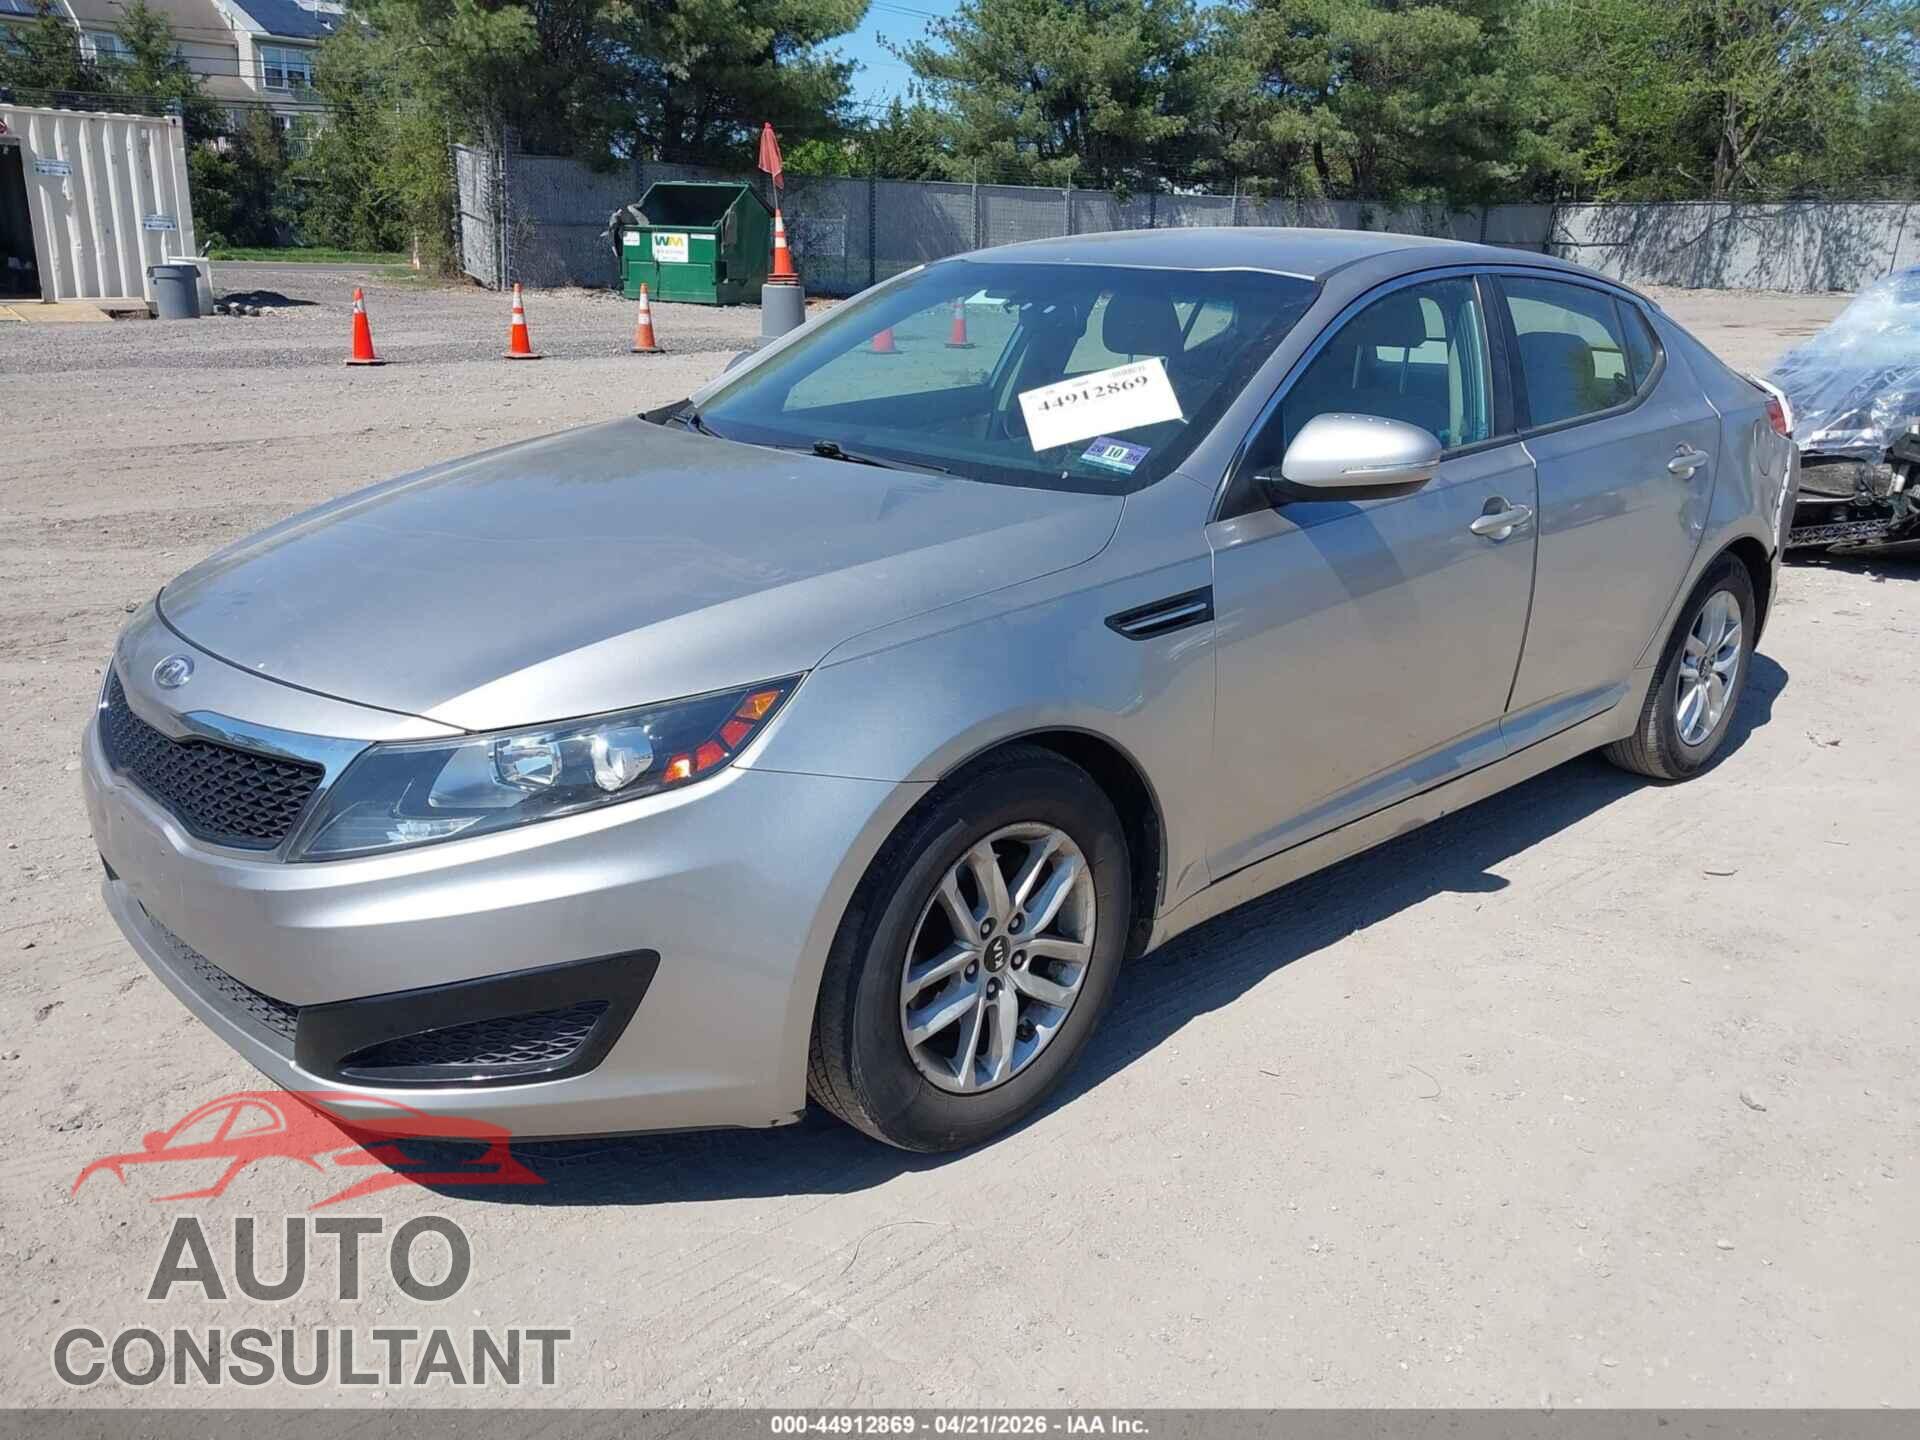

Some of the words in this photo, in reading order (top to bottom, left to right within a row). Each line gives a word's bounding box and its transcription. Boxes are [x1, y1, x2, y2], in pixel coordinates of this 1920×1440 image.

[654, 235, 684, 246] WM
[1038, 375, 1148, 411] 44912869
[1106, 447, 1124, 458] 10
[992, 940, 1004, 969] KIA
